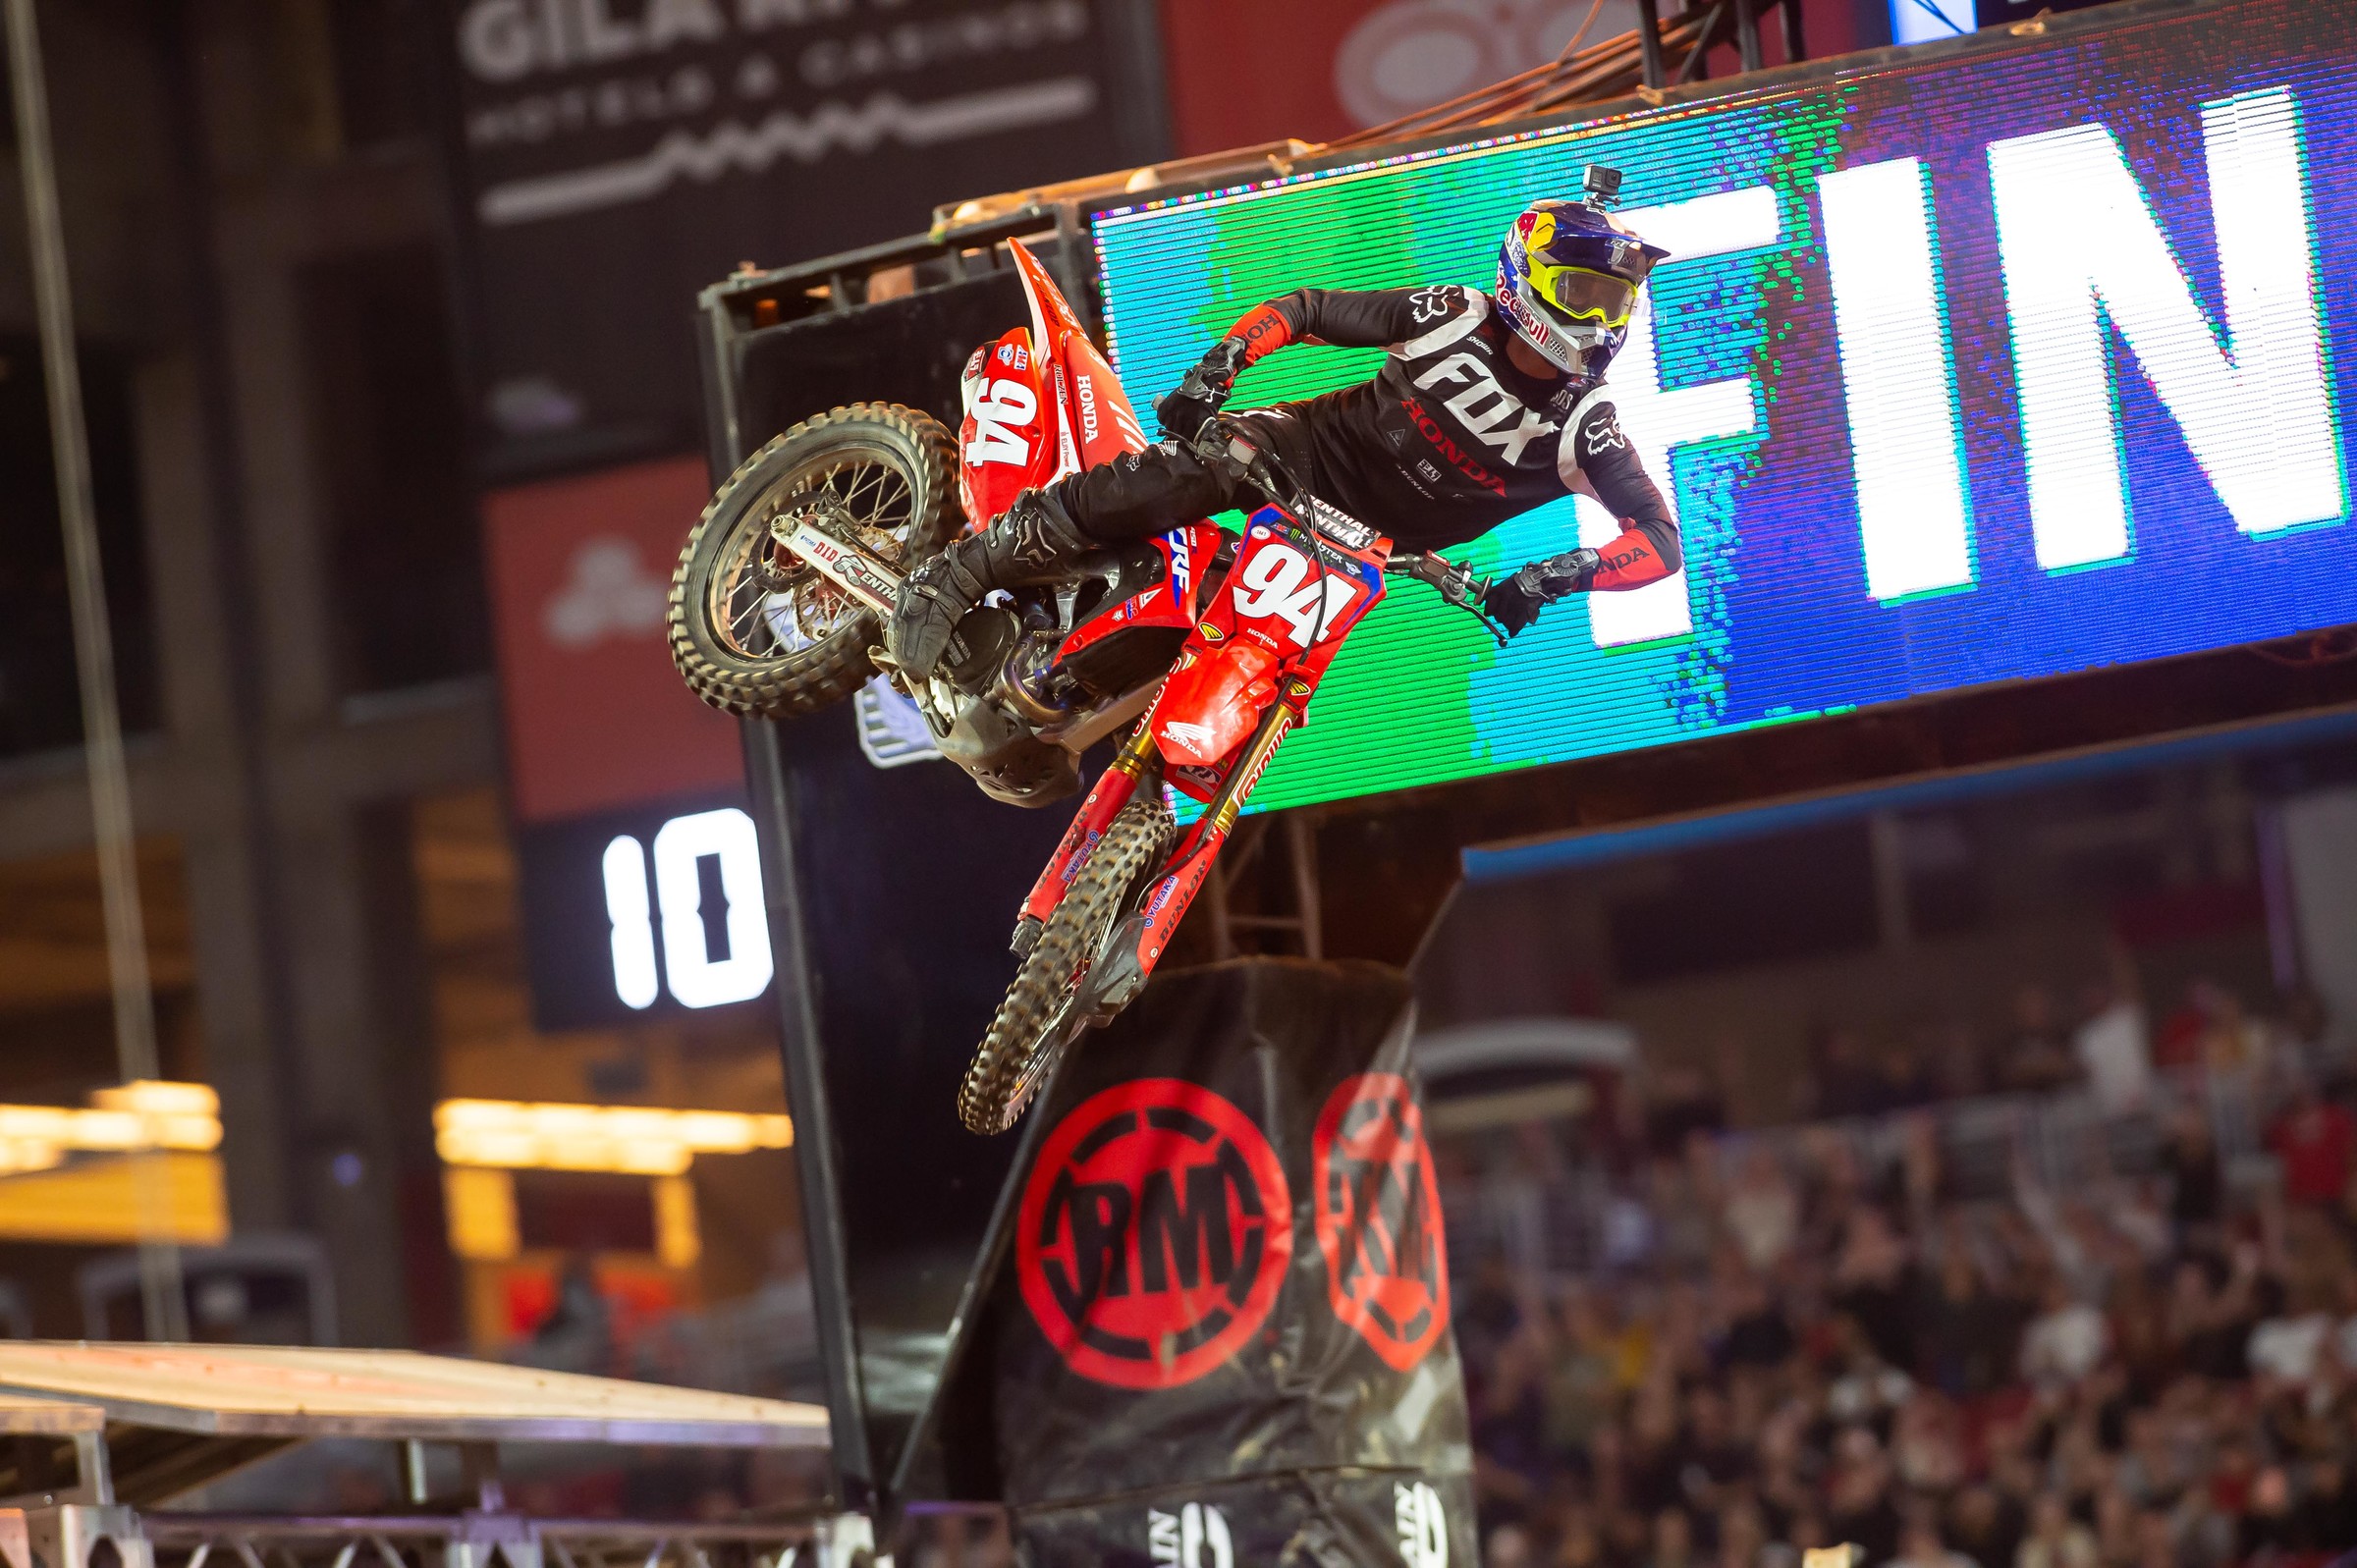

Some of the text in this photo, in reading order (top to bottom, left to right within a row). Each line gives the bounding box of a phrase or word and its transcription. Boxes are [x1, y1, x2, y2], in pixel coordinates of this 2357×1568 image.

[1466, 336, 1494, 355] SHOWA
[965, 377, 1037, 467] 94
[1076, 375, 1099, 445] HONDA
[1412, 351, 1562, 466] FOX
[1400, 397, 1507, 499] HONDA
[1401, 469, 1435, 500] DUNLOP
[1599, 547, 1650, 574] NDA
[1233, 543, 1359, 648] 94
[953, 630, 971, 660] HONDA
[1246, 627, 1278, 649] HONDA
[1160, 730, 1203, 759] HONDA
[1064, 841, 1093, 883] YUTAKA
[603, 807, 774, 1010] 10
[1147, 875, 1176, 917] YUTAKA
